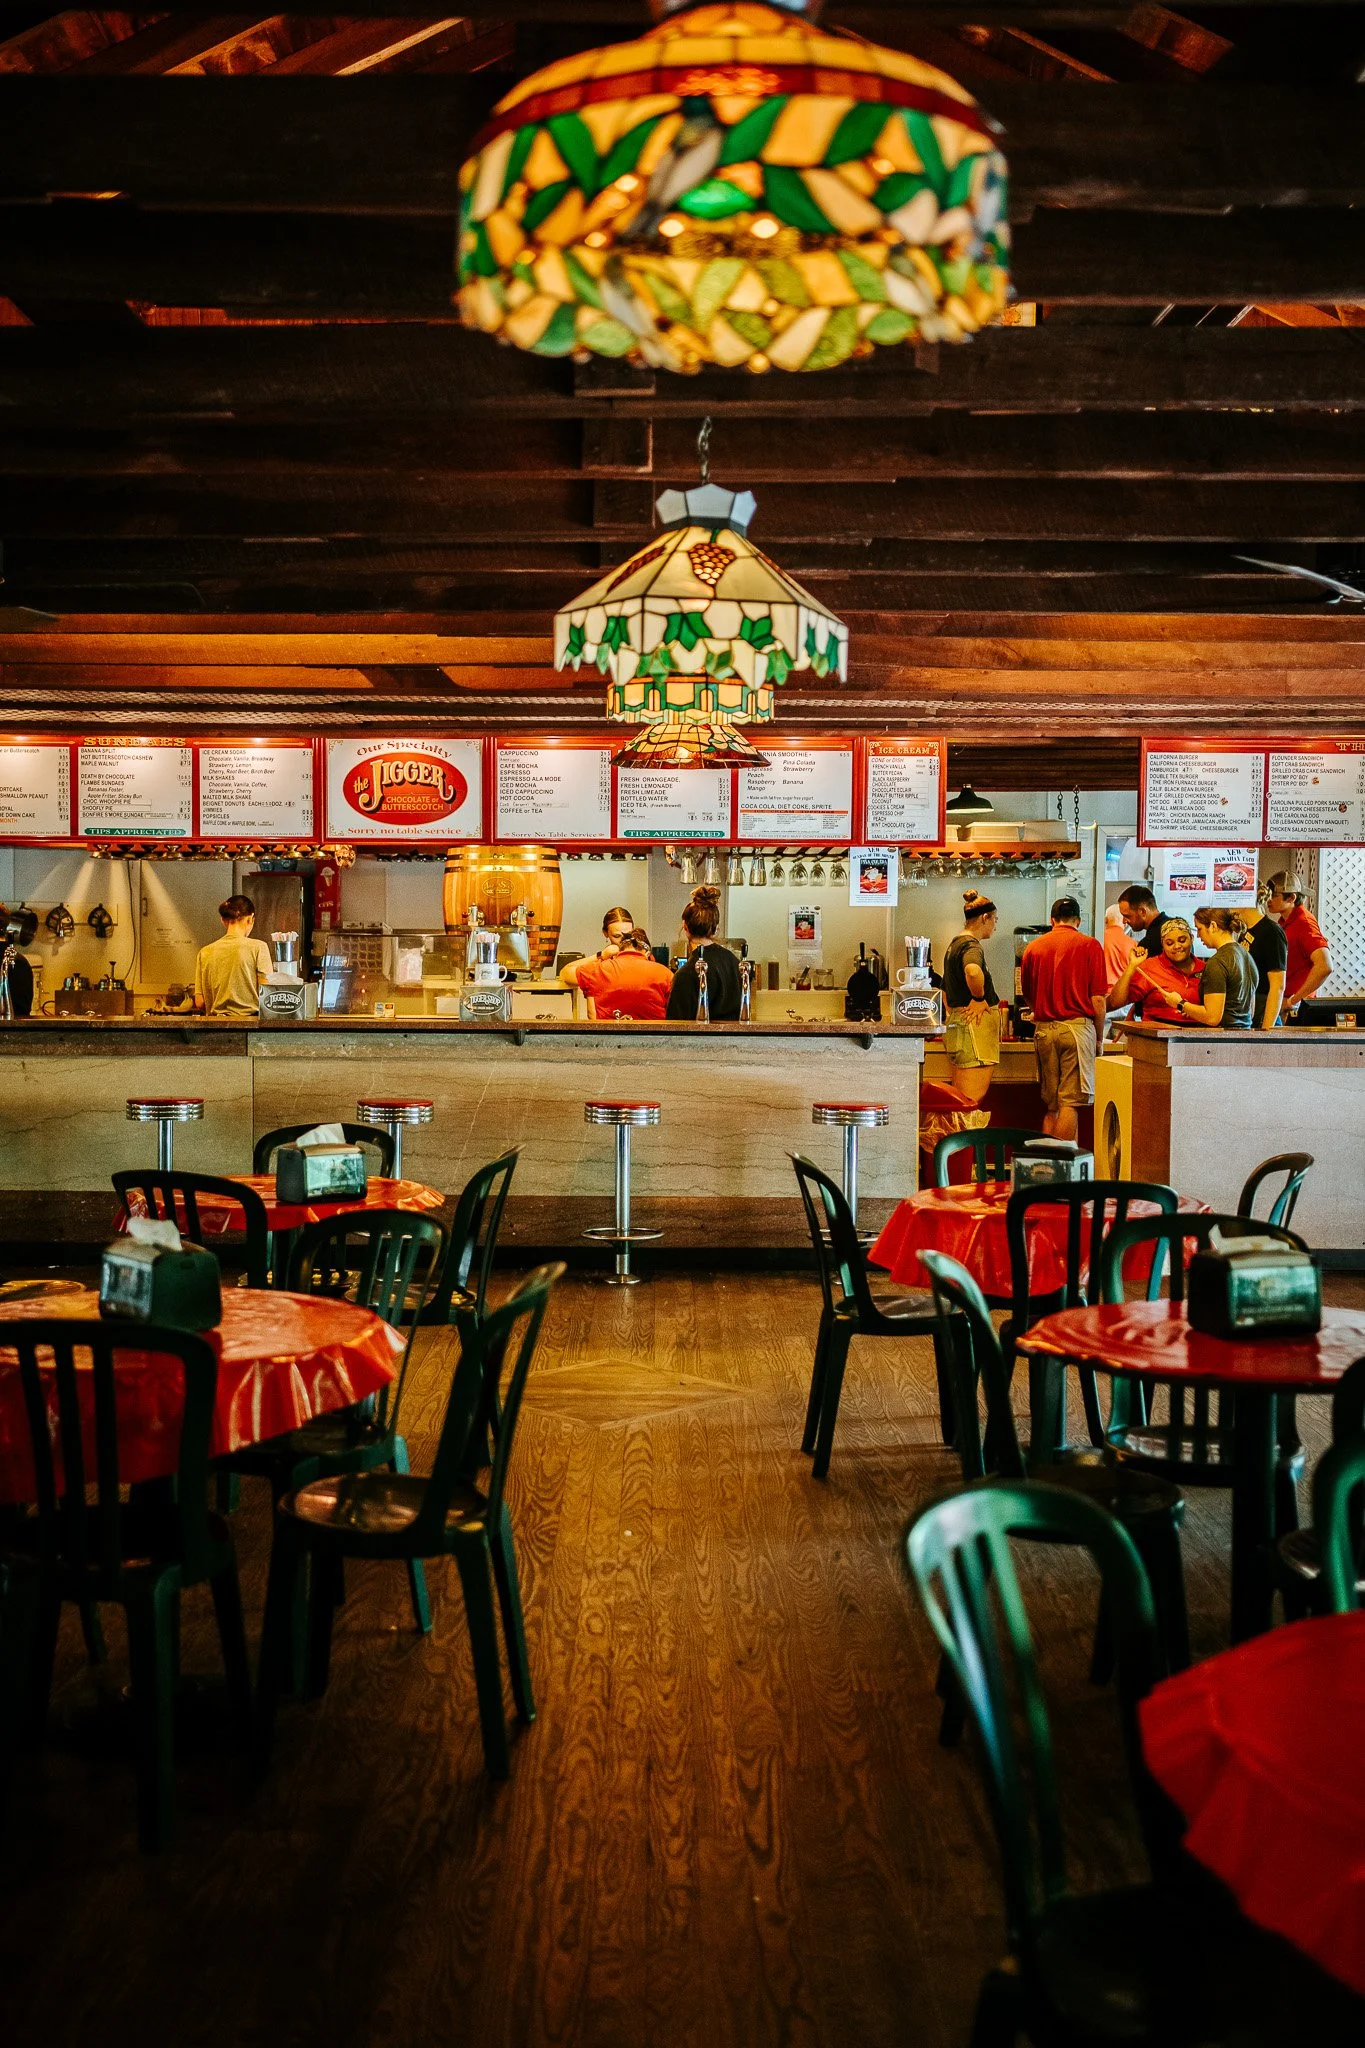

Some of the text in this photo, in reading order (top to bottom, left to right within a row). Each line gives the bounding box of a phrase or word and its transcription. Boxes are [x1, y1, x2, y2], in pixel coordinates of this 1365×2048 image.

[83, 737, 186, 746] SUNDAES
[357, 740, 452, 759] Our Specialty
[878, 746, 930, 754] ICE CREAM
[353, 759, 454, 812] the JIGGER
[386, 796, 430, 804] CHOCOLATE
[382, 803, 444, 811] BUTTERSCOTCH
[396, 827, 423, 835] table
